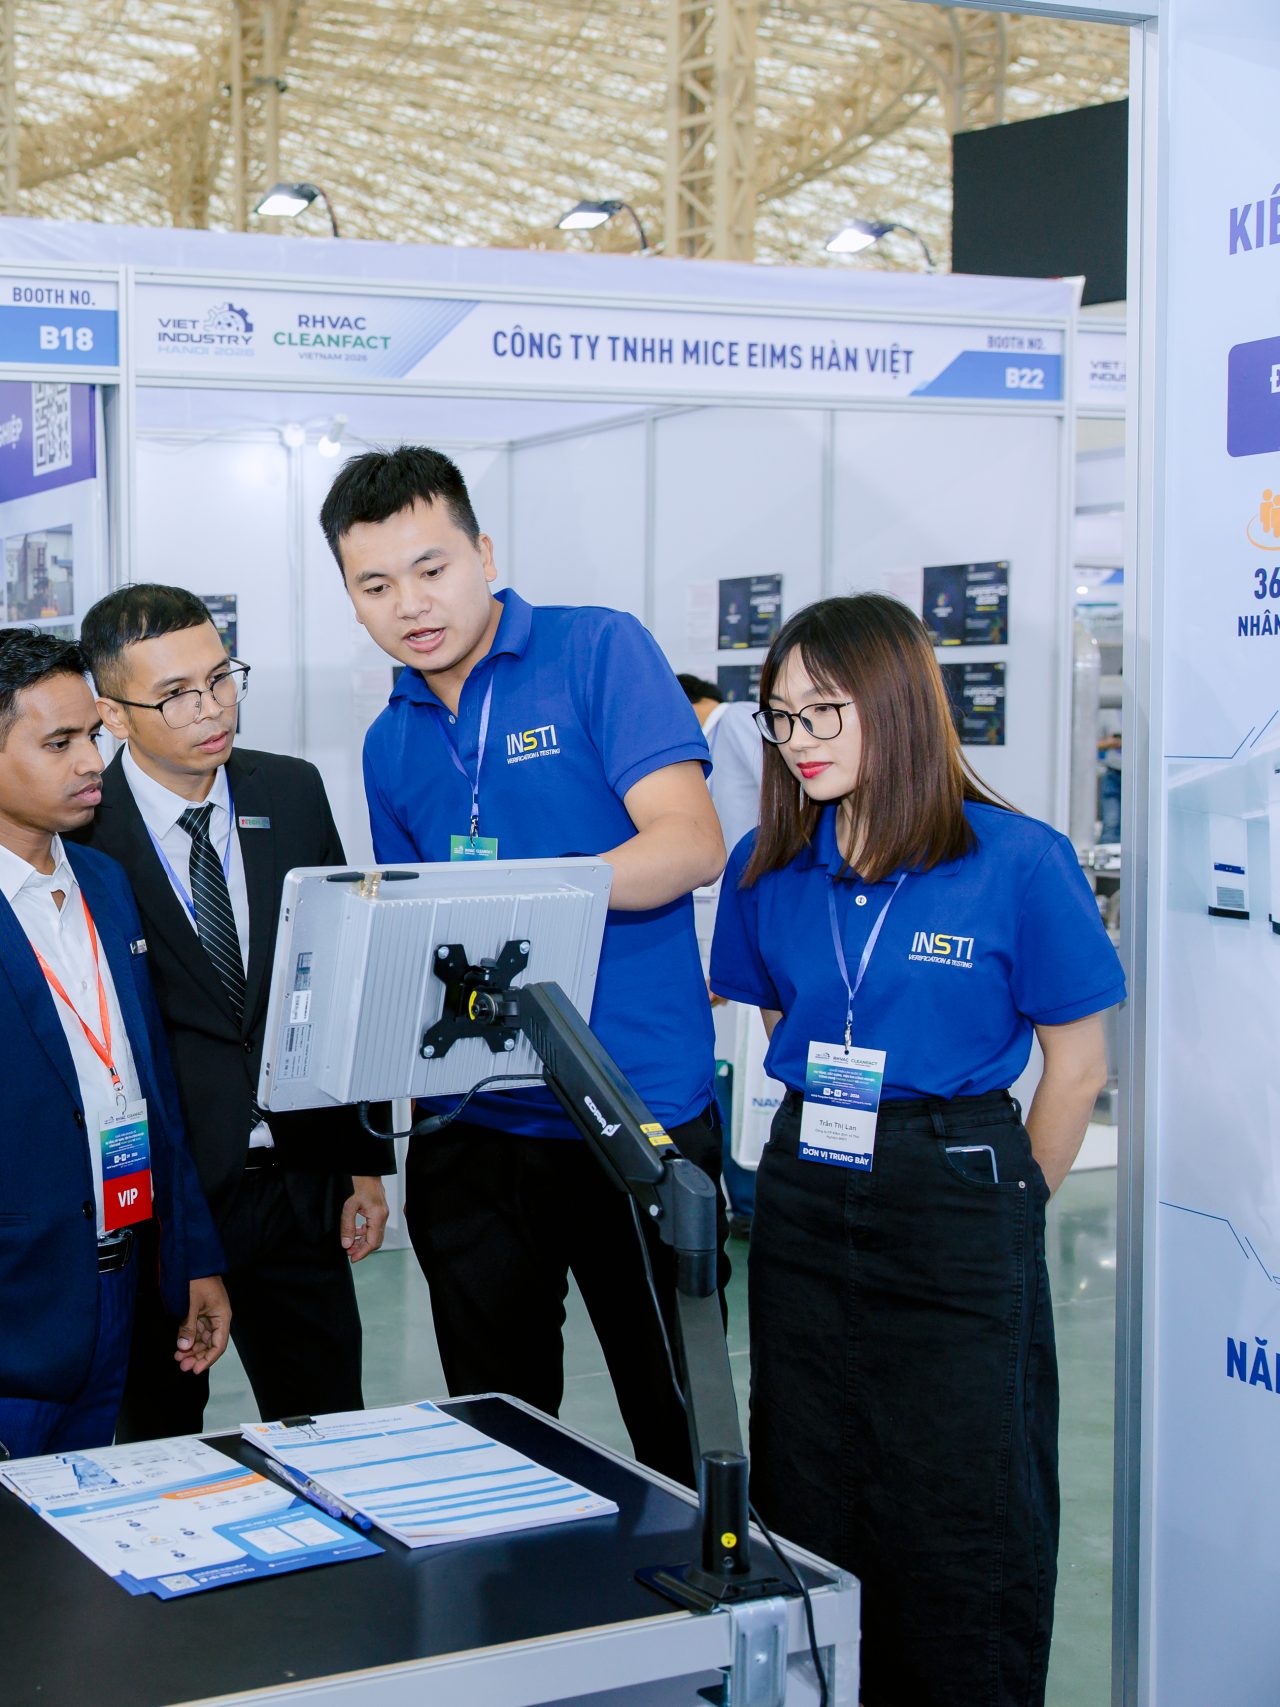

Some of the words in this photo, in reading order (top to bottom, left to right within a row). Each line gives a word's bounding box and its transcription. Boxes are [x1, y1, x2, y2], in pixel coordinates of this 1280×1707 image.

[12, 287, 64, 304] BOOTH
[70, 289, 96, 306] NO.
[158, 318, 200, 329] VIET
[297, 314, 367, 330] RHVAC
[40, 325, 94, 352] B18
[158, 332, 253, 345] INDUSTRY
[273, 331, 391, 350] CLEANFACT
[298, 352, 343, 361] VIETNAM
[493, 324, 562, 359] CÔNG
[570, 334, 600, 360] TY
[607, 336, 673, 364] TNHH
[683, 339, 739, 366] MICE
[747, 343, 803, 369] EIMS
[811, 339, 858, 372] HÀN
[866, 343, 914, 380] VIỆT
[1005, 367, 1045, 389] B22
[506, 724, 557, 755] INSTI
[911, 931, 974, 960] INSTI
[908, 953, 946, 965] VERIFICATION
[802, 1147, 819, 1157] ĐƠN
[820, 1150, 829, 1160] VỊ
[829, 1152, 854, 1163] TRƯNG
[855, 1154, 870, 1166] BÀY
[118, 1188, 138, 1208] VIP
